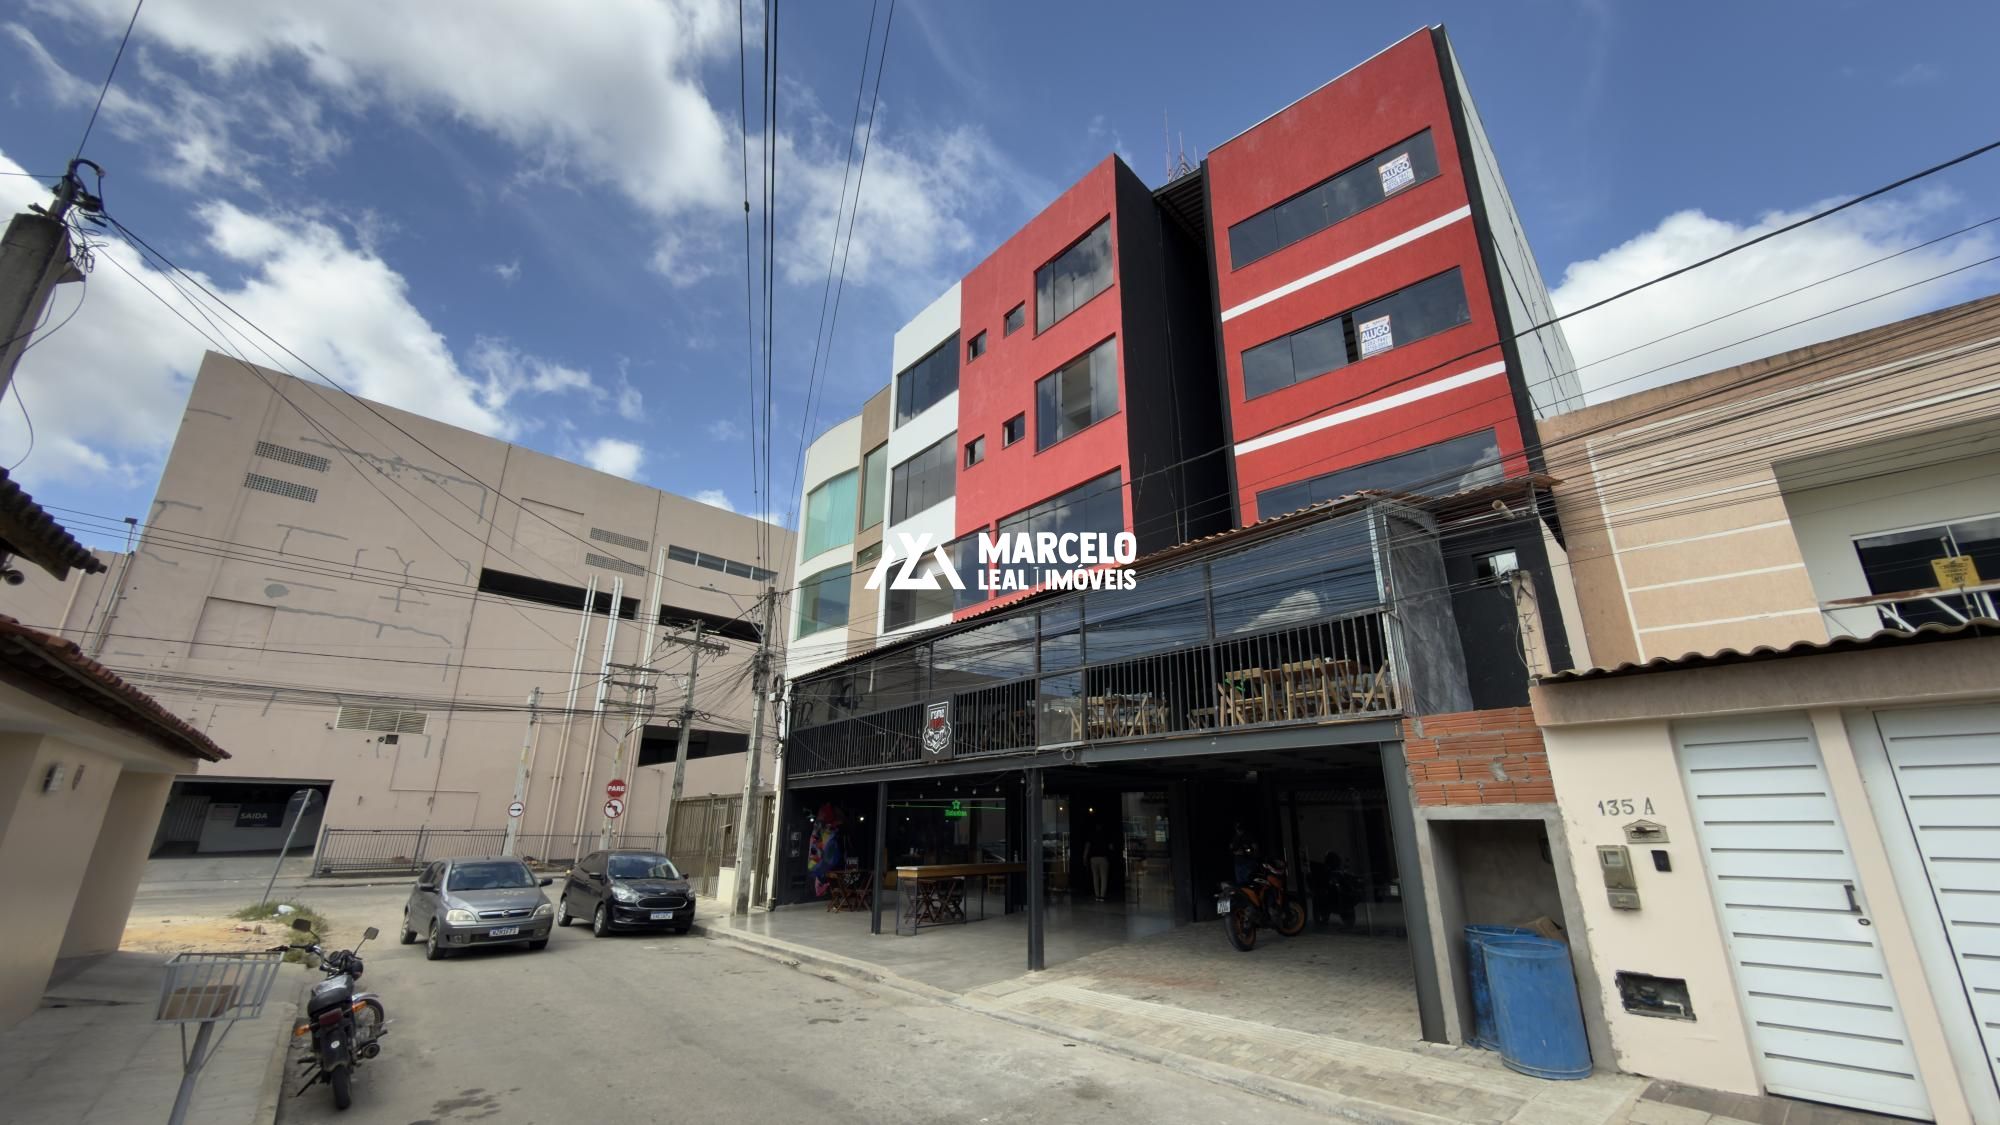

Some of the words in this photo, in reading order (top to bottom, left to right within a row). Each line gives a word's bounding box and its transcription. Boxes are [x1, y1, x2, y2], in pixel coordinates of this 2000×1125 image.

[1382, 160, 1410, 182] ALUGO
[1361, 324, 1390, 343] ALUGO
[1597, 799, 1635, 816] 135
[1644, 796, 1656, 815] A
